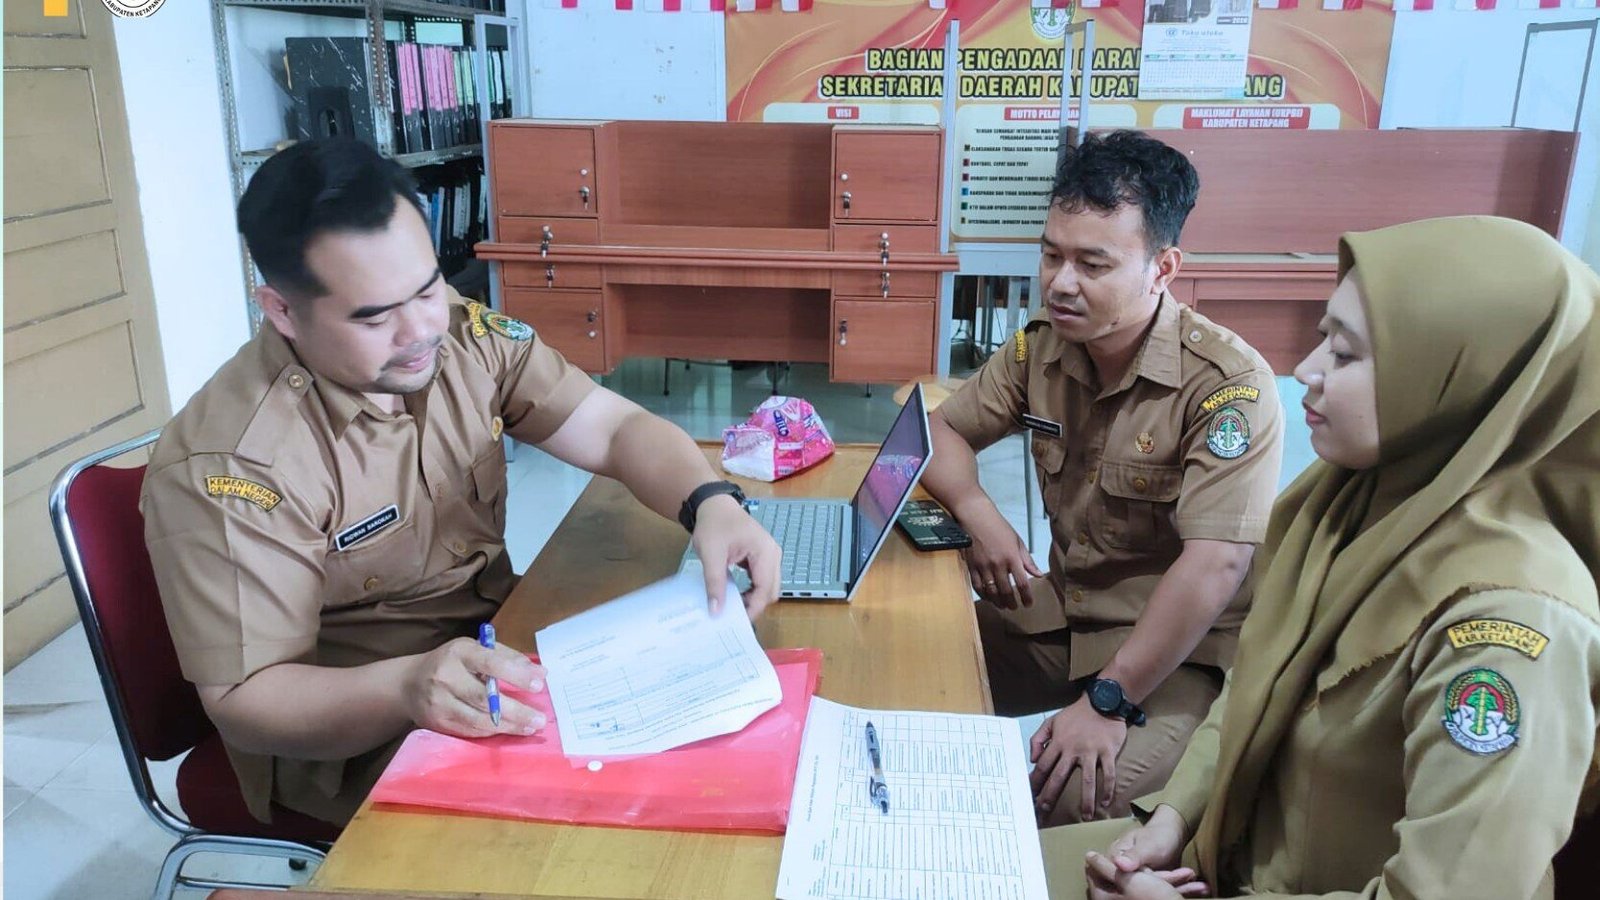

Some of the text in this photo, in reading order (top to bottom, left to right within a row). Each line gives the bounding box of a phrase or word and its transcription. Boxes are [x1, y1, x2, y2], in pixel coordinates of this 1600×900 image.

[868, 48, 944, 70] BAGIAN
[821, 76, 944, 97] SEKRETARIA
[960, 76, 1043, 97] DAERAH
[836, 108, 852, 117] VISI
[1010, 110, 1037, 118] MOTTO
[1191, 108, 1234, 117] MAKLUMAT
[1236, 108, 1271, 117] LAYANAN
[1202, 119, 1289, 128] KABUPATEN KETAPANG
[210, 478, 277, 503] KEMENTERIAN
[210, 486, 273, 508] DALAM NEGERI
[1453, 622, 1540, 642] PEMERINTAH
